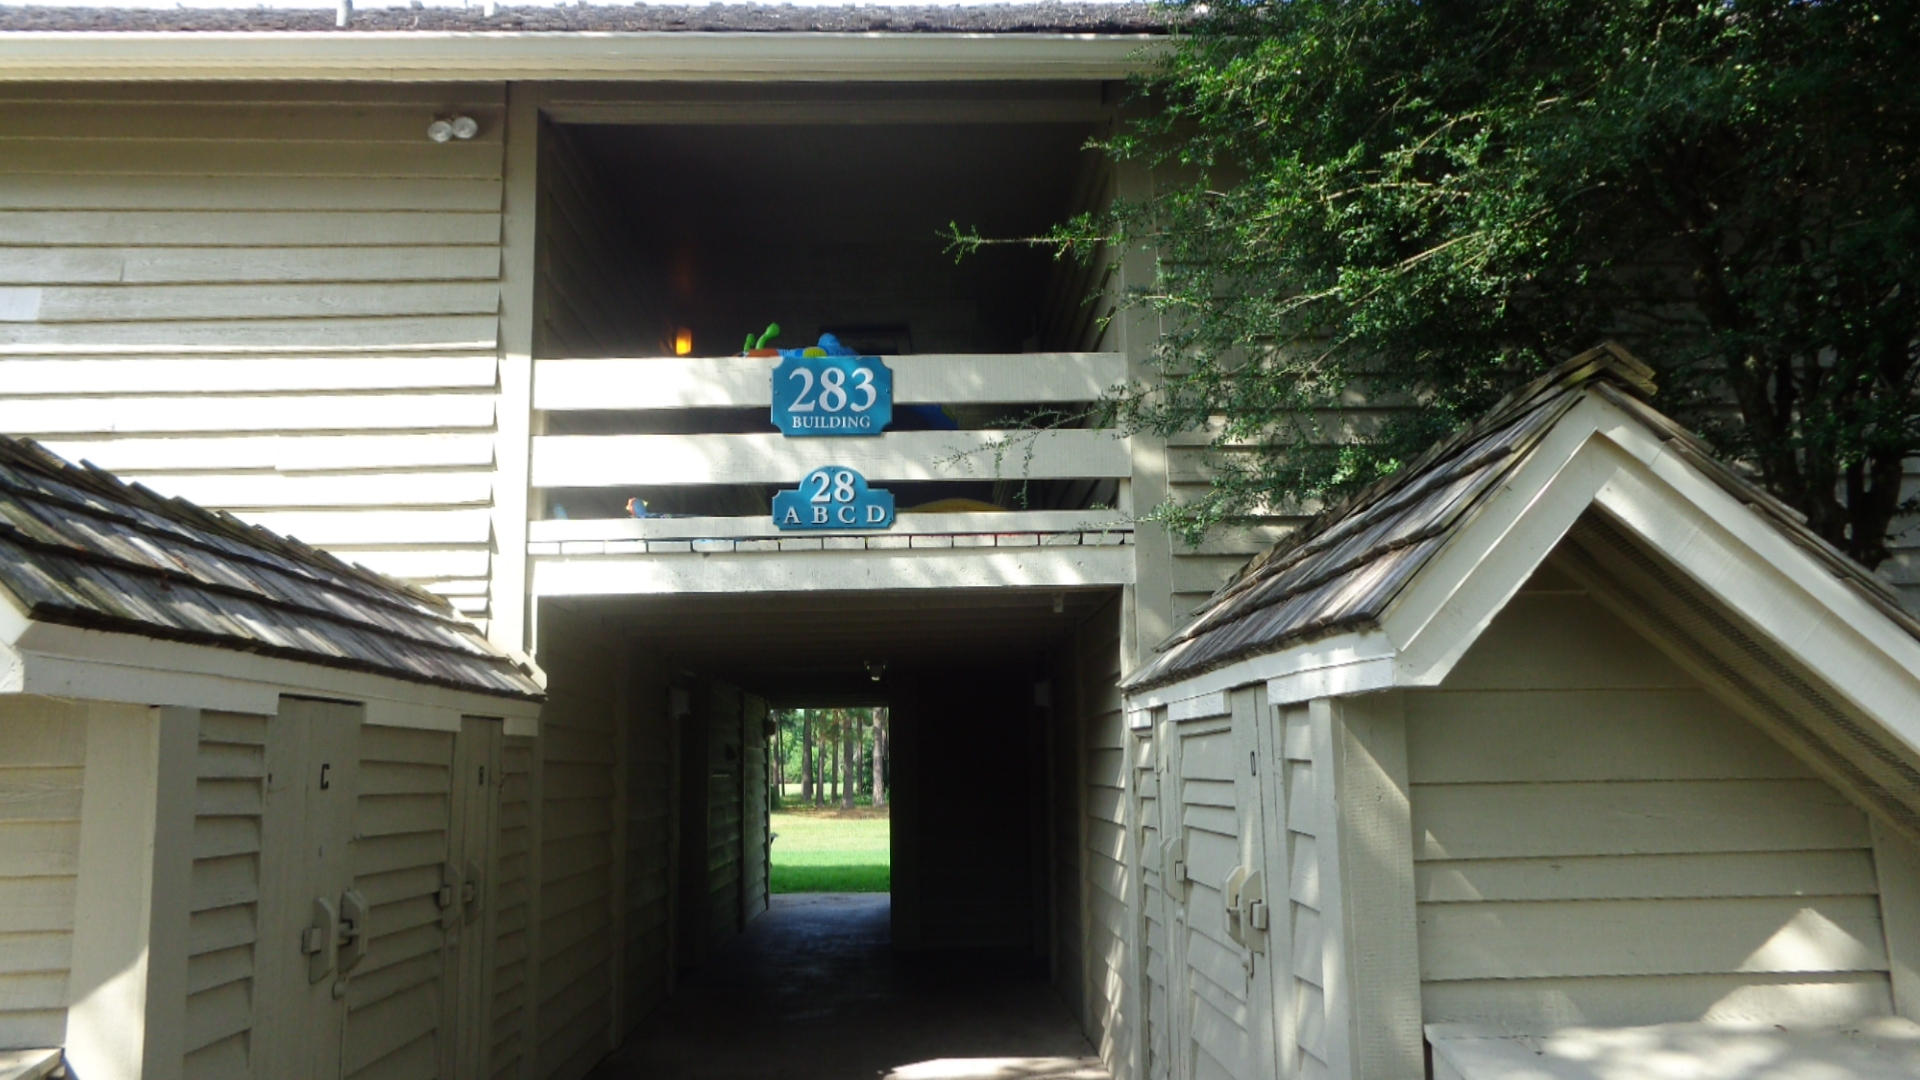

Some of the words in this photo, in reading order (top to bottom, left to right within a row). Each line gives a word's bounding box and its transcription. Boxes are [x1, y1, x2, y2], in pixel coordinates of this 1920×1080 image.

[788, 367, 877, 411] 283
[792, 416, 870, 429] BUILDING
[810, 471, 855, 503] 28
[784, 506, 801, 524] A
[811, 506, 829, 524] B
[837, 506, 856, 524] C
[866, 505, 886, 523] D
[320, 763, 330, 790] C
